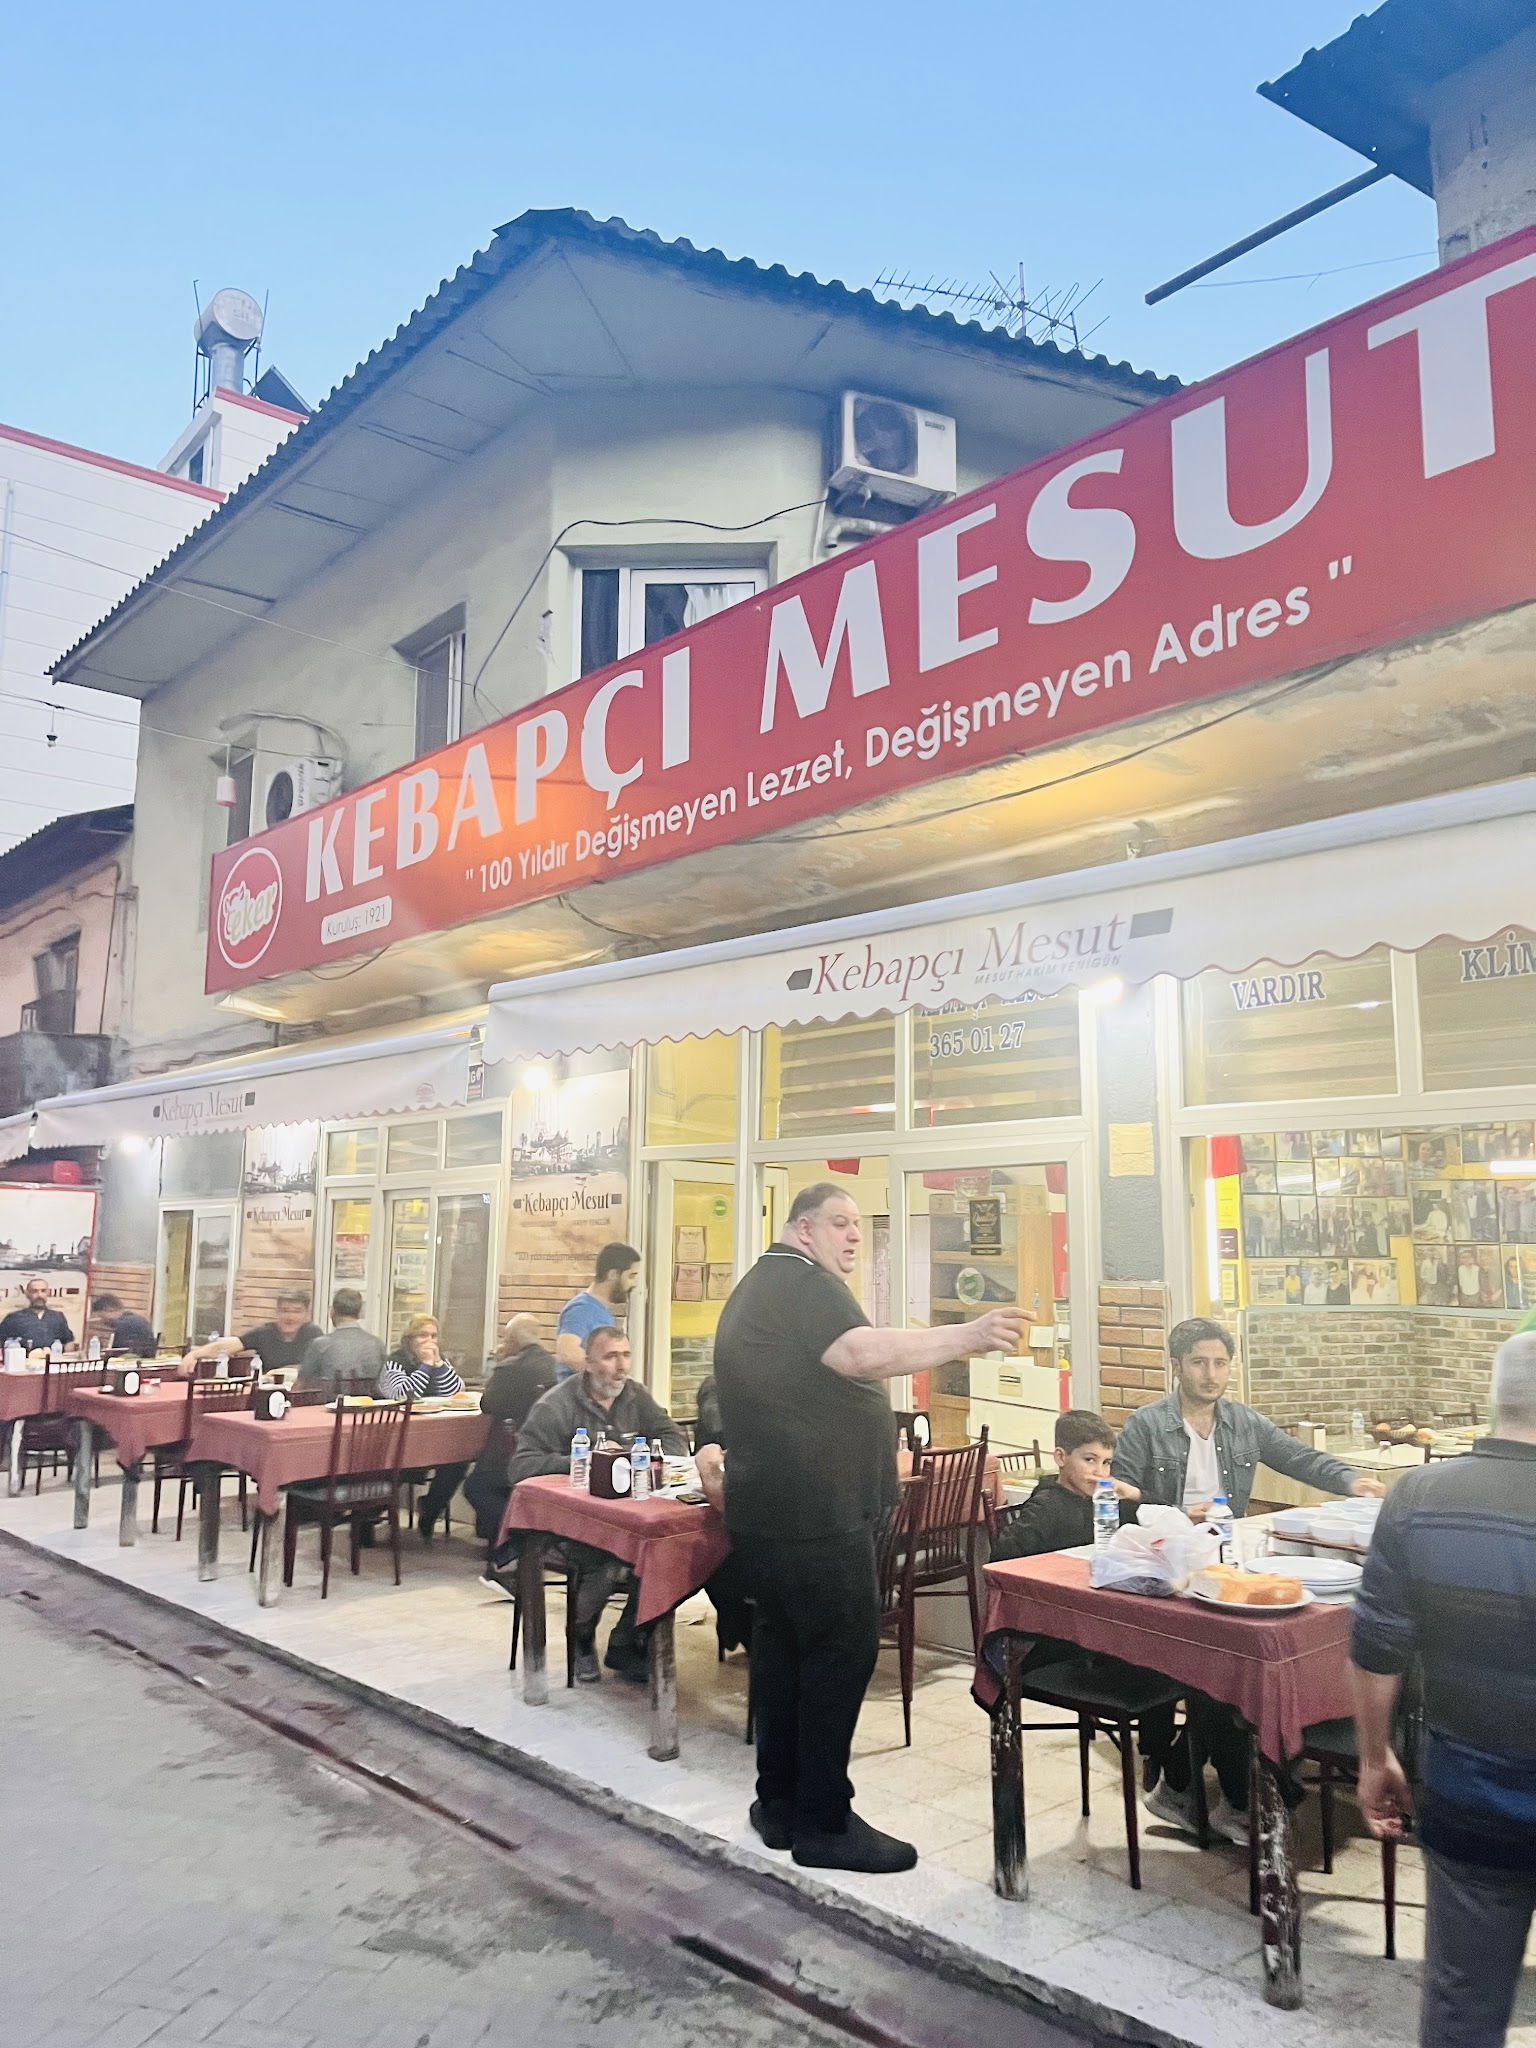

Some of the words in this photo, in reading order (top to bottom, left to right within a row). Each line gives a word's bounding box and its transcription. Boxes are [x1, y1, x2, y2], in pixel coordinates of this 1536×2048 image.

[304, 646, 690, 902] KEBAPÇI
[760, 252, 1536, 733] MESUT
[479, 857, 512, 893] 100
[518, 842, 569, 880] Yıldır
[576, 785, 736, 859] Değişmeyen
[747, 739, 852, 808] Lezzet,
[866, 648, 1132, 767] Değişmeyen
[1149, 580, 1311, 675] Adres
[364, 902, 386, 926] 1921
[813, 944, 964, 1001] Kebapçı
[979, 912, 1126, 971] Mesut
[974, 969, 1015, 985] MESUT
[1230, 970, 1326, 1011] VARDIR
[929, 1027, 964, 1059] 365
[970, 1025, 994, 1055] 01
[999, 1020, 1025, 1050] 27
[521, 1192, 569, 1217] Kebapçı
[571, 1186, 609, 1211] Mesut
